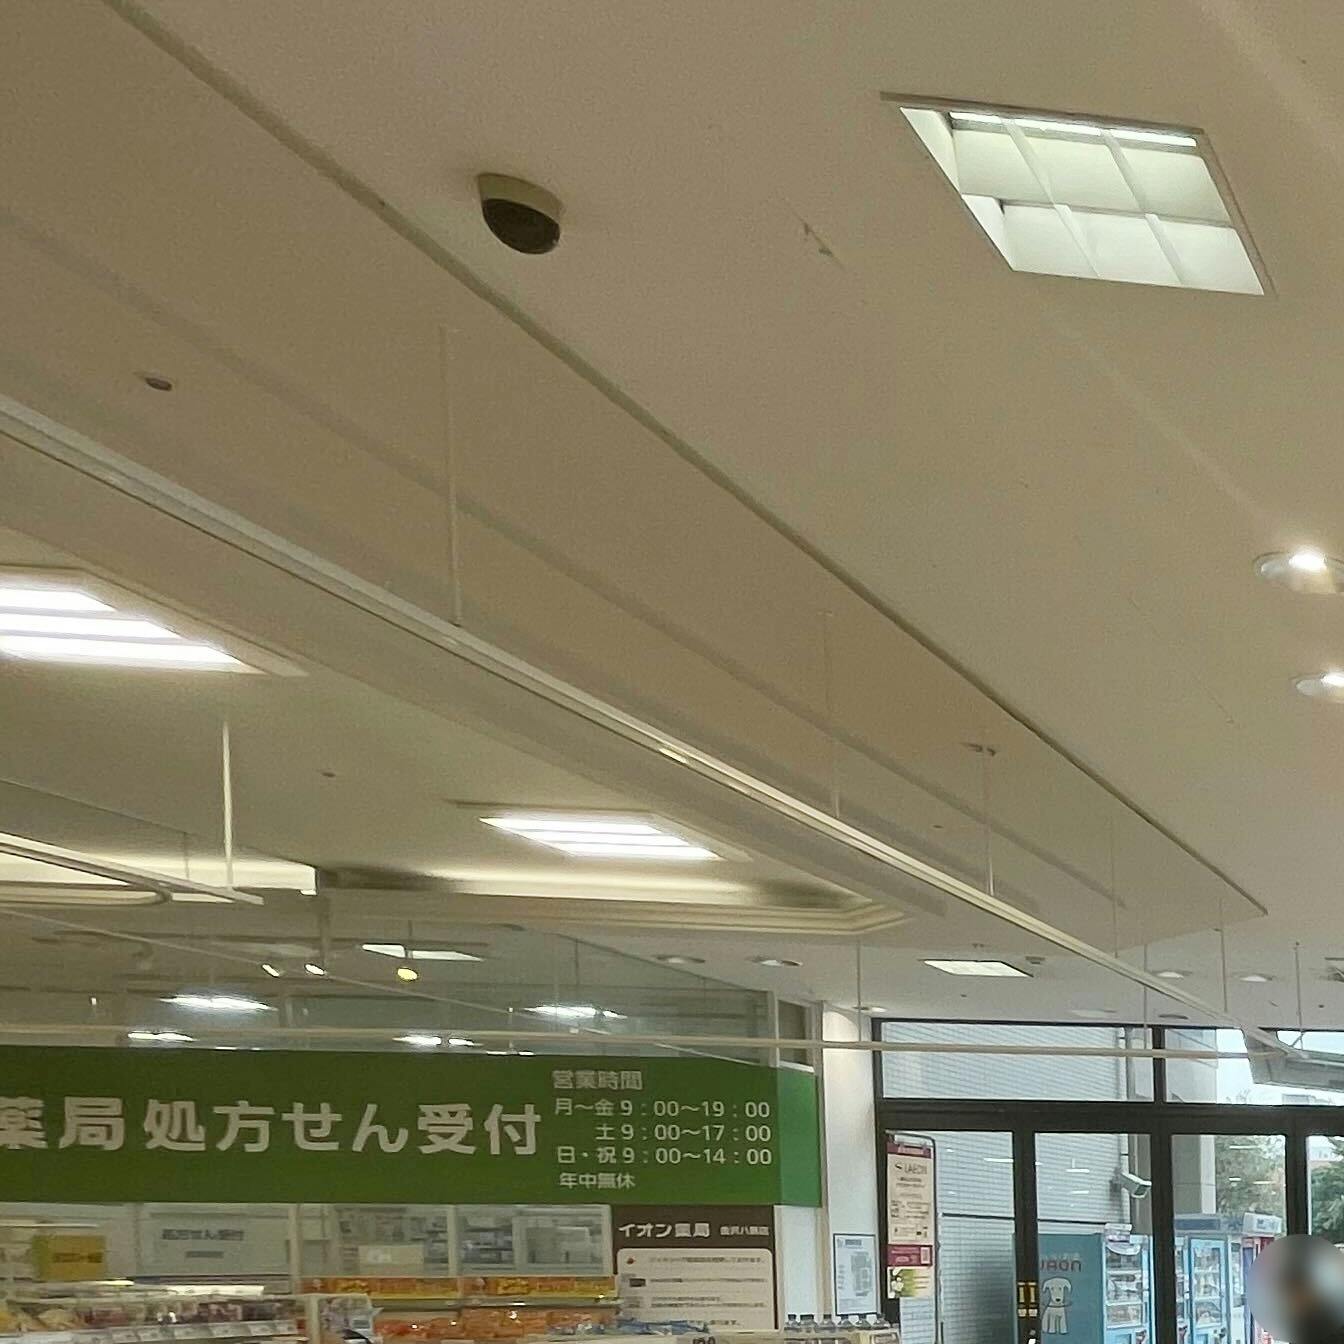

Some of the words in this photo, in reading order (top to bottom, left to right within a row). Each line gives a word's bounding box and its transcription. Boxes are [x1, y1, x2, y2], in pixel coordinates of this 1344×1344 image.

[552, 1070, 643, 1090] 営業時間
[143, 1098, 542, 1155] 処方せん受付
[559, 1172, 636, 1190] 年中無休
